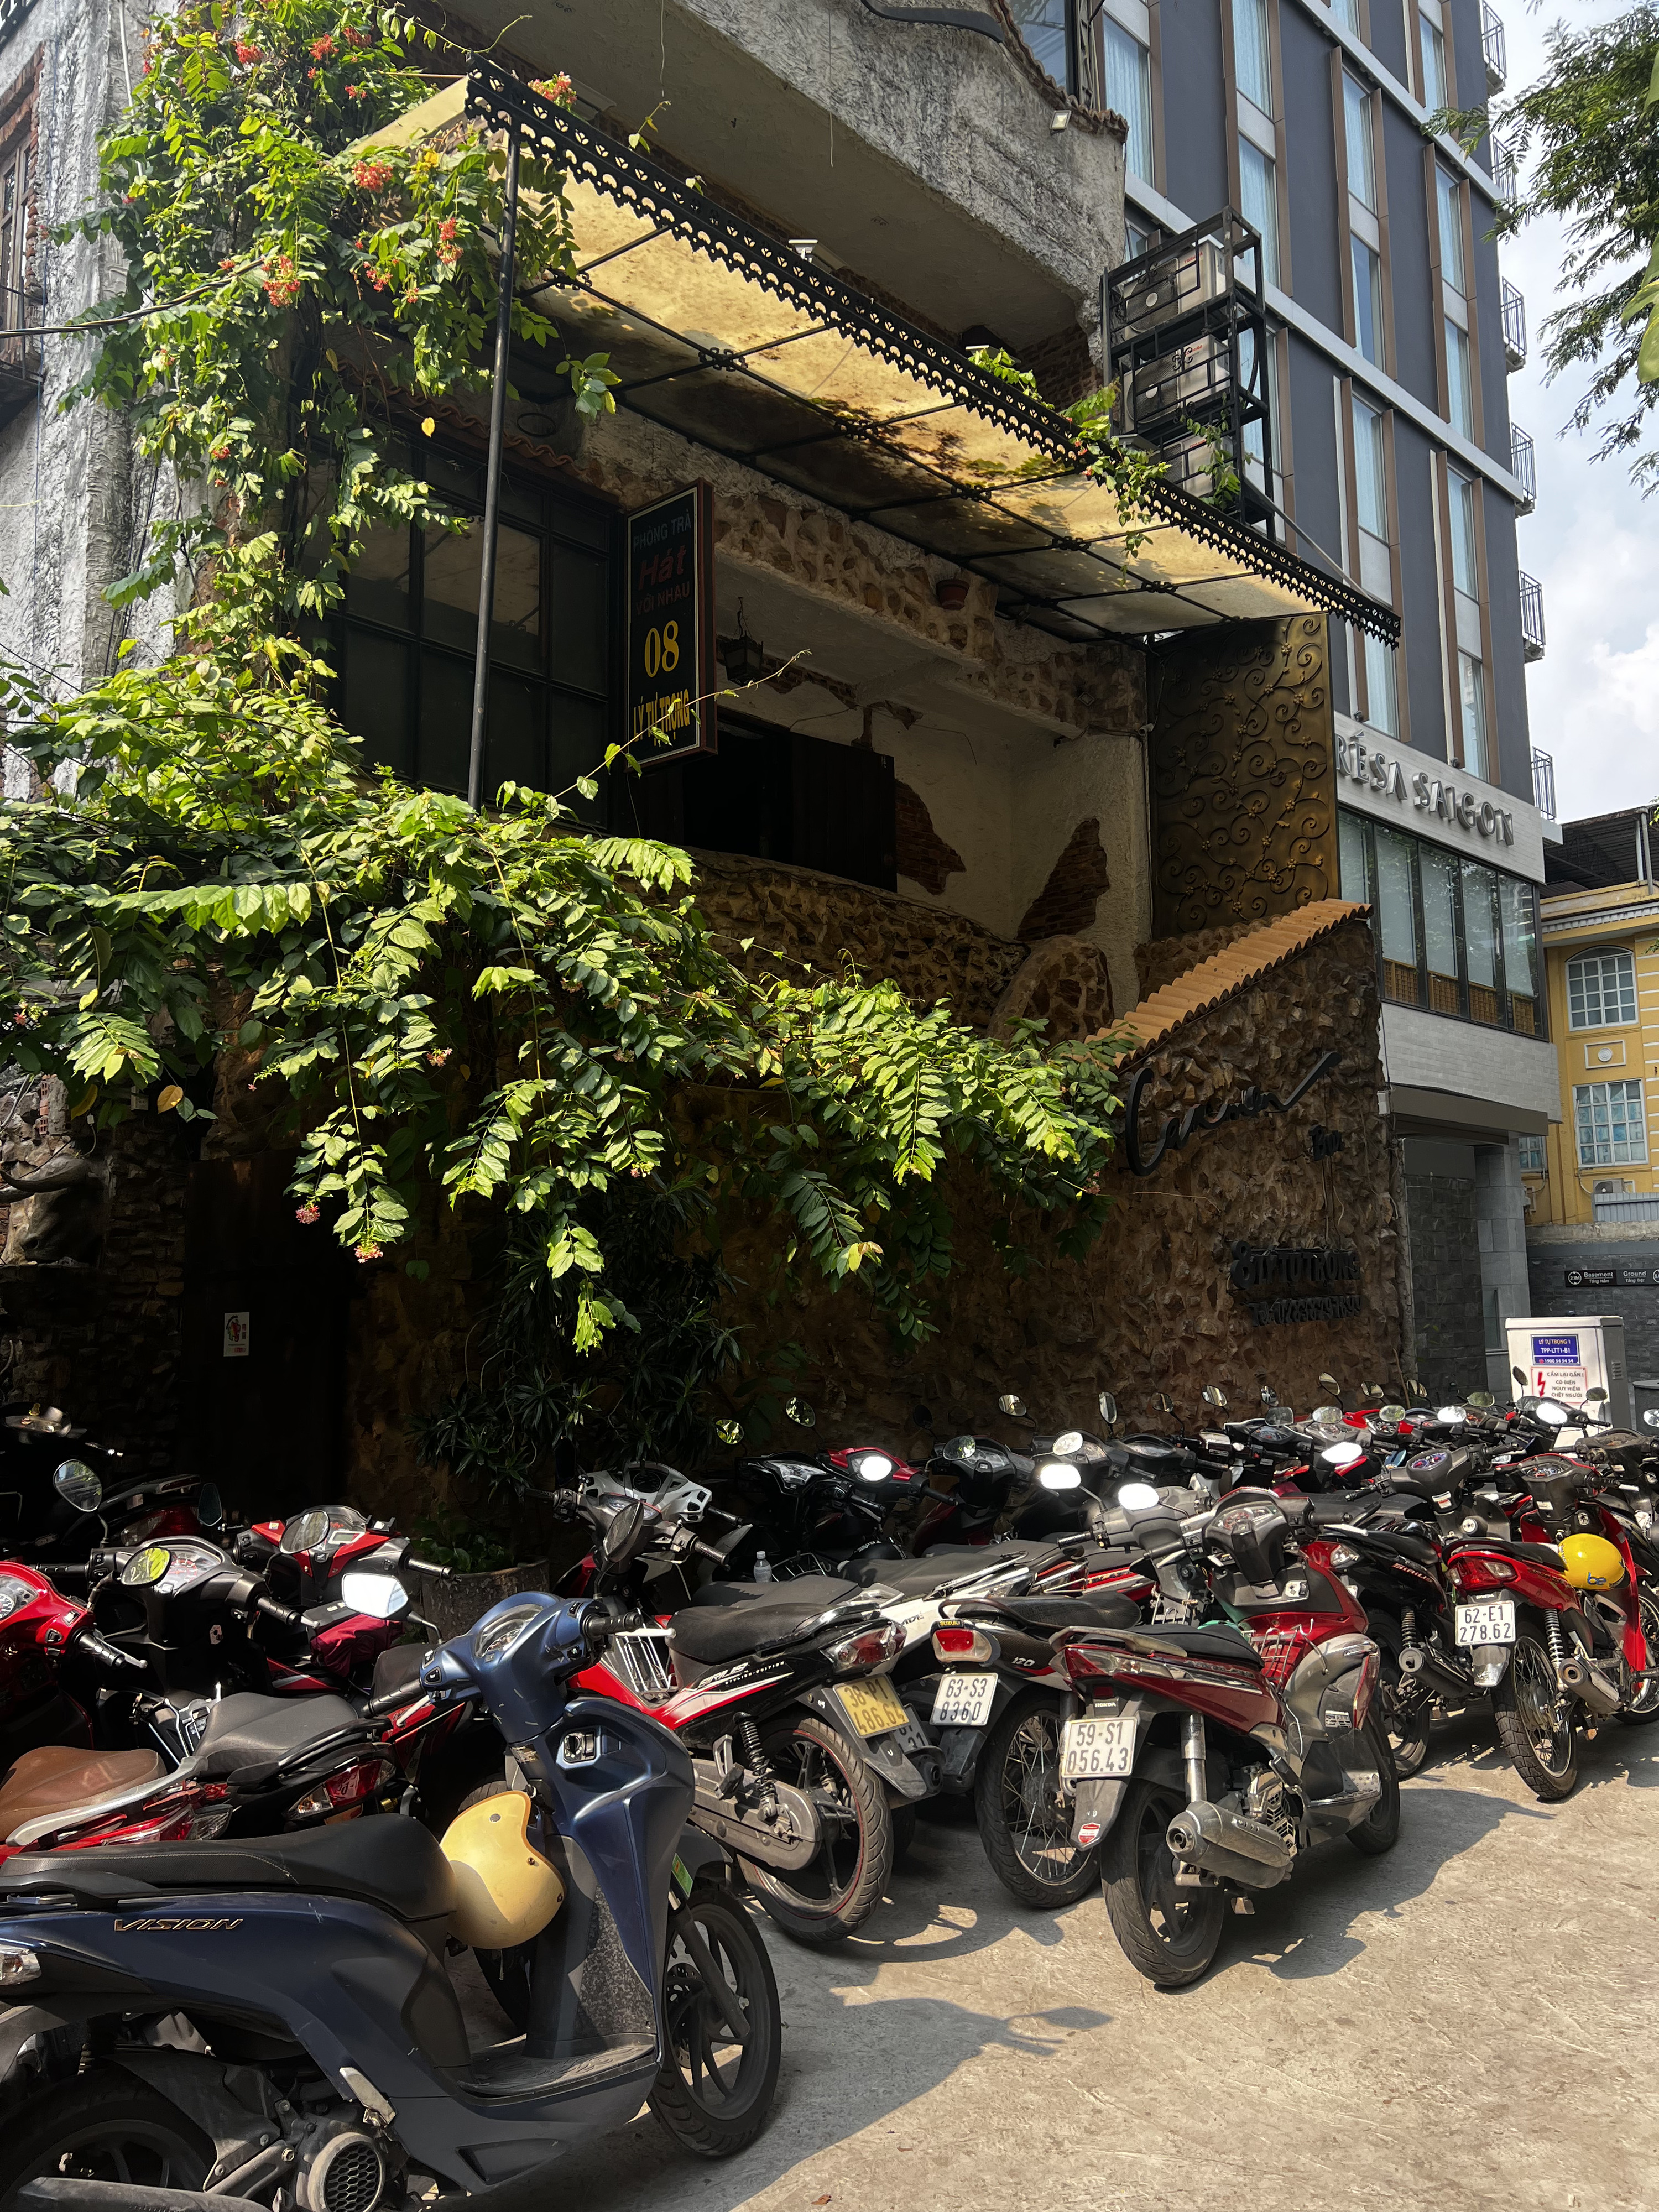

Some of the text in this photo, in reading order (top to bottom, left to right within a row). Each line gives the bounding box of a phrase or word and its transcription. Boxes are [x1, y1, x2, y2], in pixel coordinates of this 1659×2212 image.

[633, 508, 692, 552] PHÒNG TRÀ
[638, 544, 687, 591] Hát
[658, 581, 690, 607] NHAU
[644, 620, 680, 678] 08
[633, 695, 645, 742] LÝ
[1412, 772, 1515, 846] SAIGON
[1230, 1240, 1256, 1289] 8
[1587, 1572, 1606, 1585] be
[901, 1612, 925, 1625] ADE
[1465, 1605, 1503, 1624] 62-E1
[1460, 1623, 1511, 1642] 278.62
[844, 1679, 888, 1708] 38-P1
[946, 1678, 988, 1698] 63-S3
[854, 1702, 906, 1733] 486.64
[940, 1700, 982, 1721] 8360
[1076, 1721, 1123, 1747] 59-S1
[1067, 1747, 1129, 1773] 056.43
[113, 1917, 244, 1932] VISION
